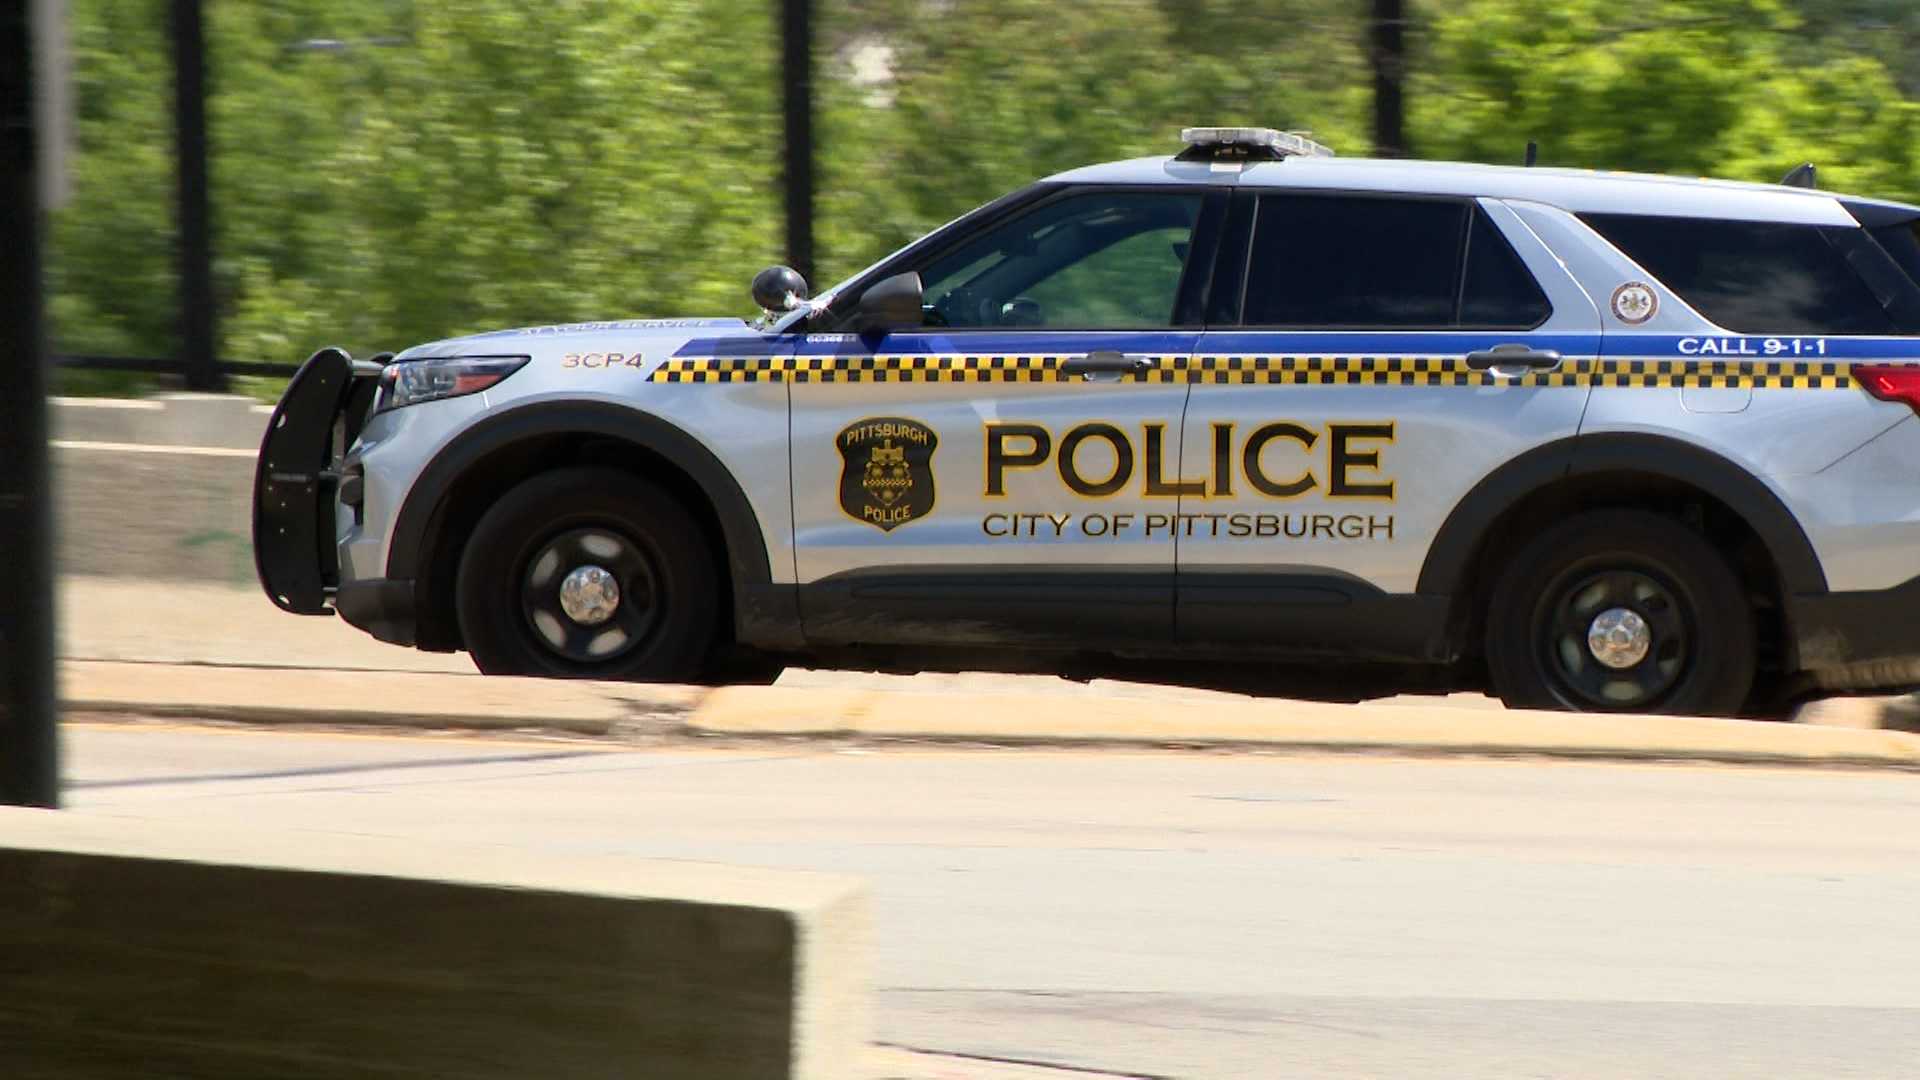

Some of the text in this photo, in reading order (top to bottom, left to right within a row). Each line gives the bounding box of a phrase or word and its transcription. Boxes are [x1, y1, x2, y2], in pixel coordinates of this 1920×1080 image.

[1677, 337, 1826, 354] CALL 9-1-1
[562, 352, 642, 369] 3CP4
[846, 423, 928, 446] PITTSBURGH
[983, 421, 1396, 499] POLICE
[863, 504, 912, 522] POLICE
[982, 513, 1394, 539] CITY OF PITTSBURGH
